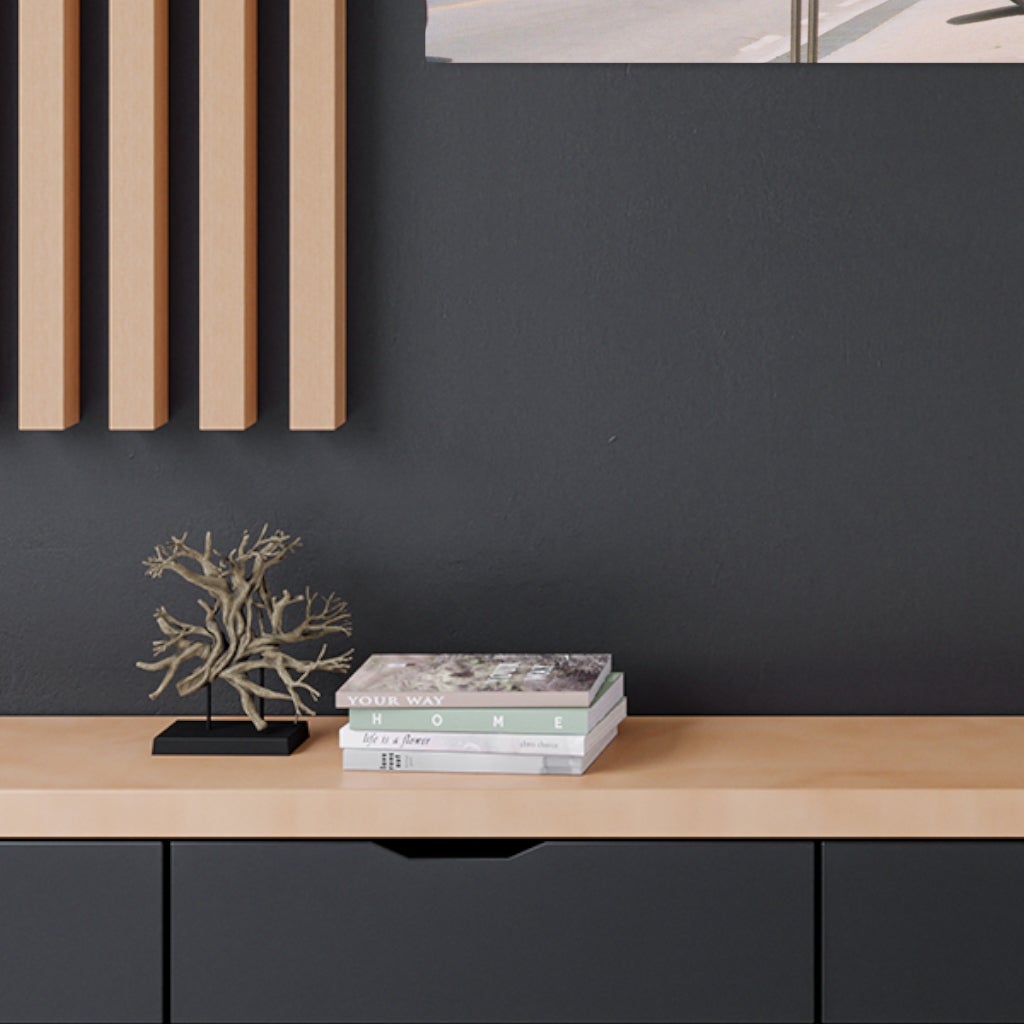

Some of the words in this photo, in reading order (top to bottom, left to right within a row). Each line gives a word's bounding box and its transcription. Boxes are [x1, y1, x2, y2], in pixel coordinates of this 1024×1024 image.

[347, 695, 400, 706] YOUR
[406, 695, 445, 706] WAY
[362, 732, 378, 747] life
[400, 733, 431, 748] flower
